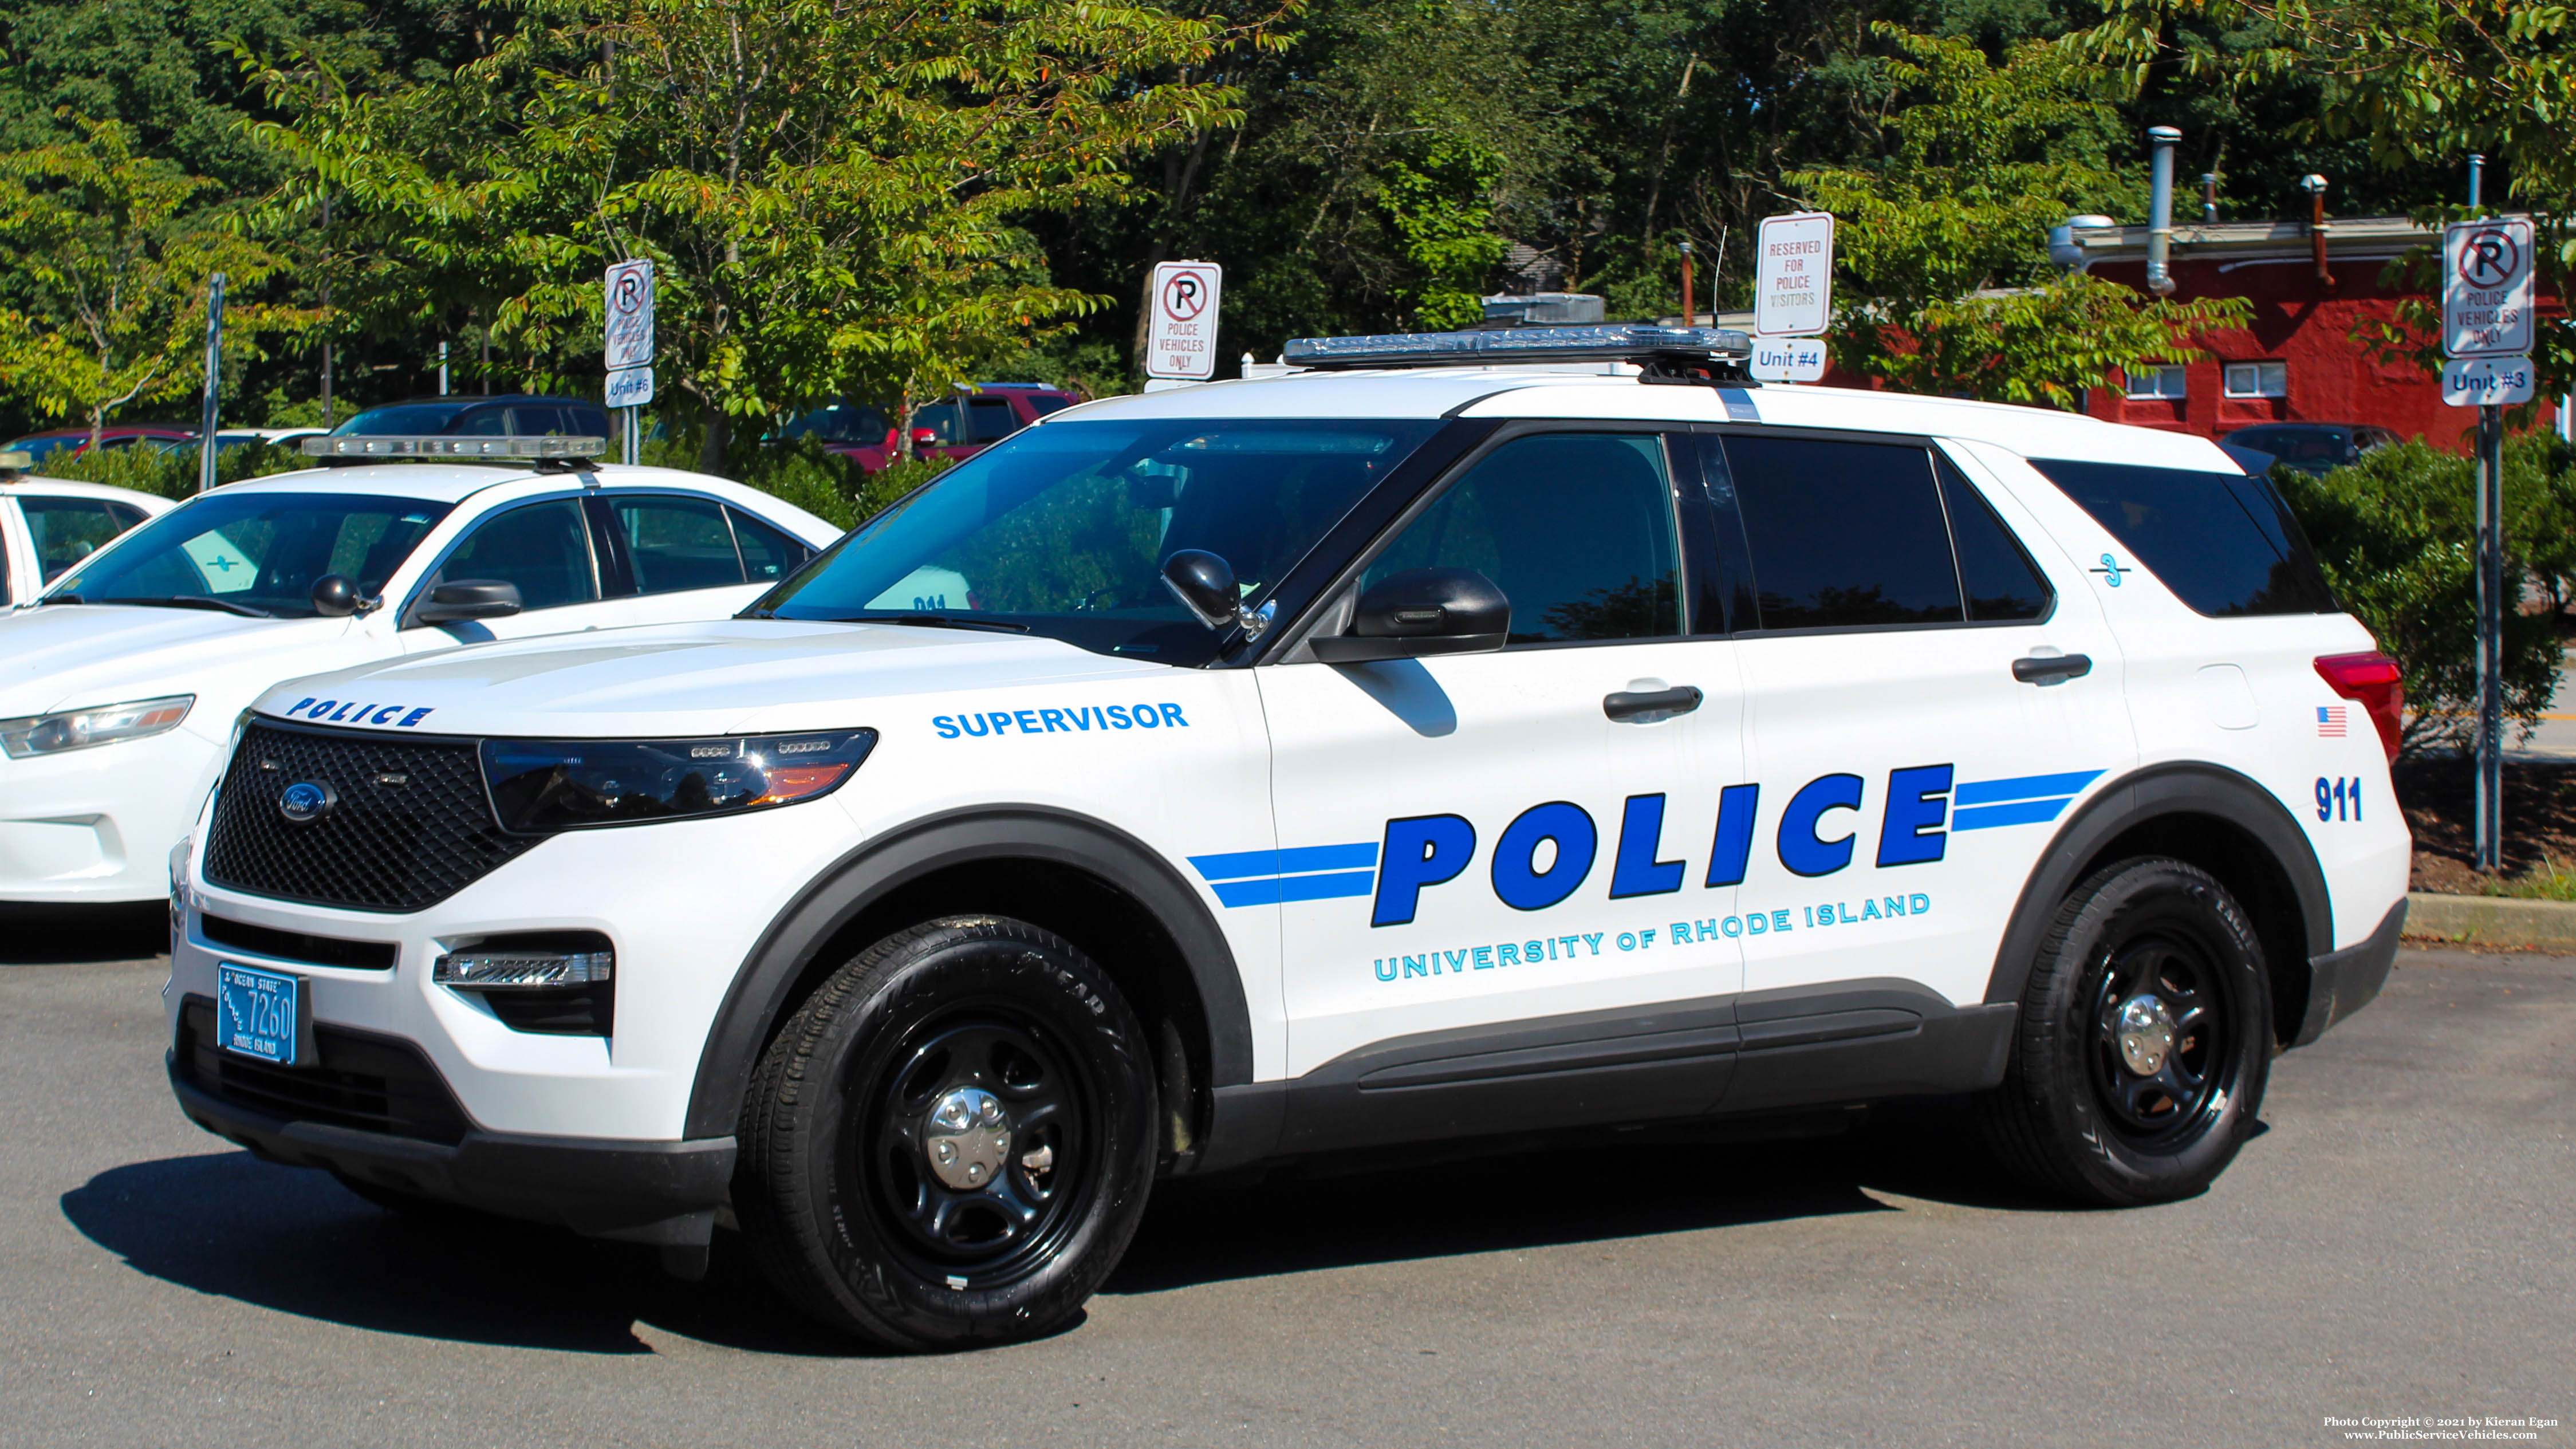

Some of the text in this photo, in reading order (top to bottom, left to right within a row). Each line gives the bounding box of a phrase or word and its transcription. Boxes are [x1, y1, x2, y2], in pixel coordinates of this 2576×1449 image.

[1770, 241, 1821, 257] RESERVED
[1785, 259, 1803, 272] FOR
[1777, 275, 1810, 290] POLICE
[1770, 293, 1814, 308] VISITORS
[2467, 291, 2507, 306] POLICE
[2457, 309, 2518, 326] VEHICLES
[1167, 323, 1198, 336] POLICE
[2473, 329, 2501, 344] ONLY
[1160, 338, 1204, 352] VEHICLES
[1169, 355, 1192, 368] ONLY
[1759, 351, 1818, 367] Unit #4
[610, 378, 648, 396] Unit #6
[2453, 372, 2526, 391] Unit #3
[285, 697, 436, 727] POLICE
[932, 702, 1190, 739] SUPERVISOR
[287, 790, 312, 812] Ford
[2315, 776, 2362, 822] 911
[1370, 762, 1954, 928] POLICE
[1373, 893, 1931, 982] UNIVERSITY OF RHODE ISLAND
[222, 984, 243, 1031] POLICE
[248, 990, 290, 1041] 7260
[233, 1033, 276, 1055] RHODE ISLAND
